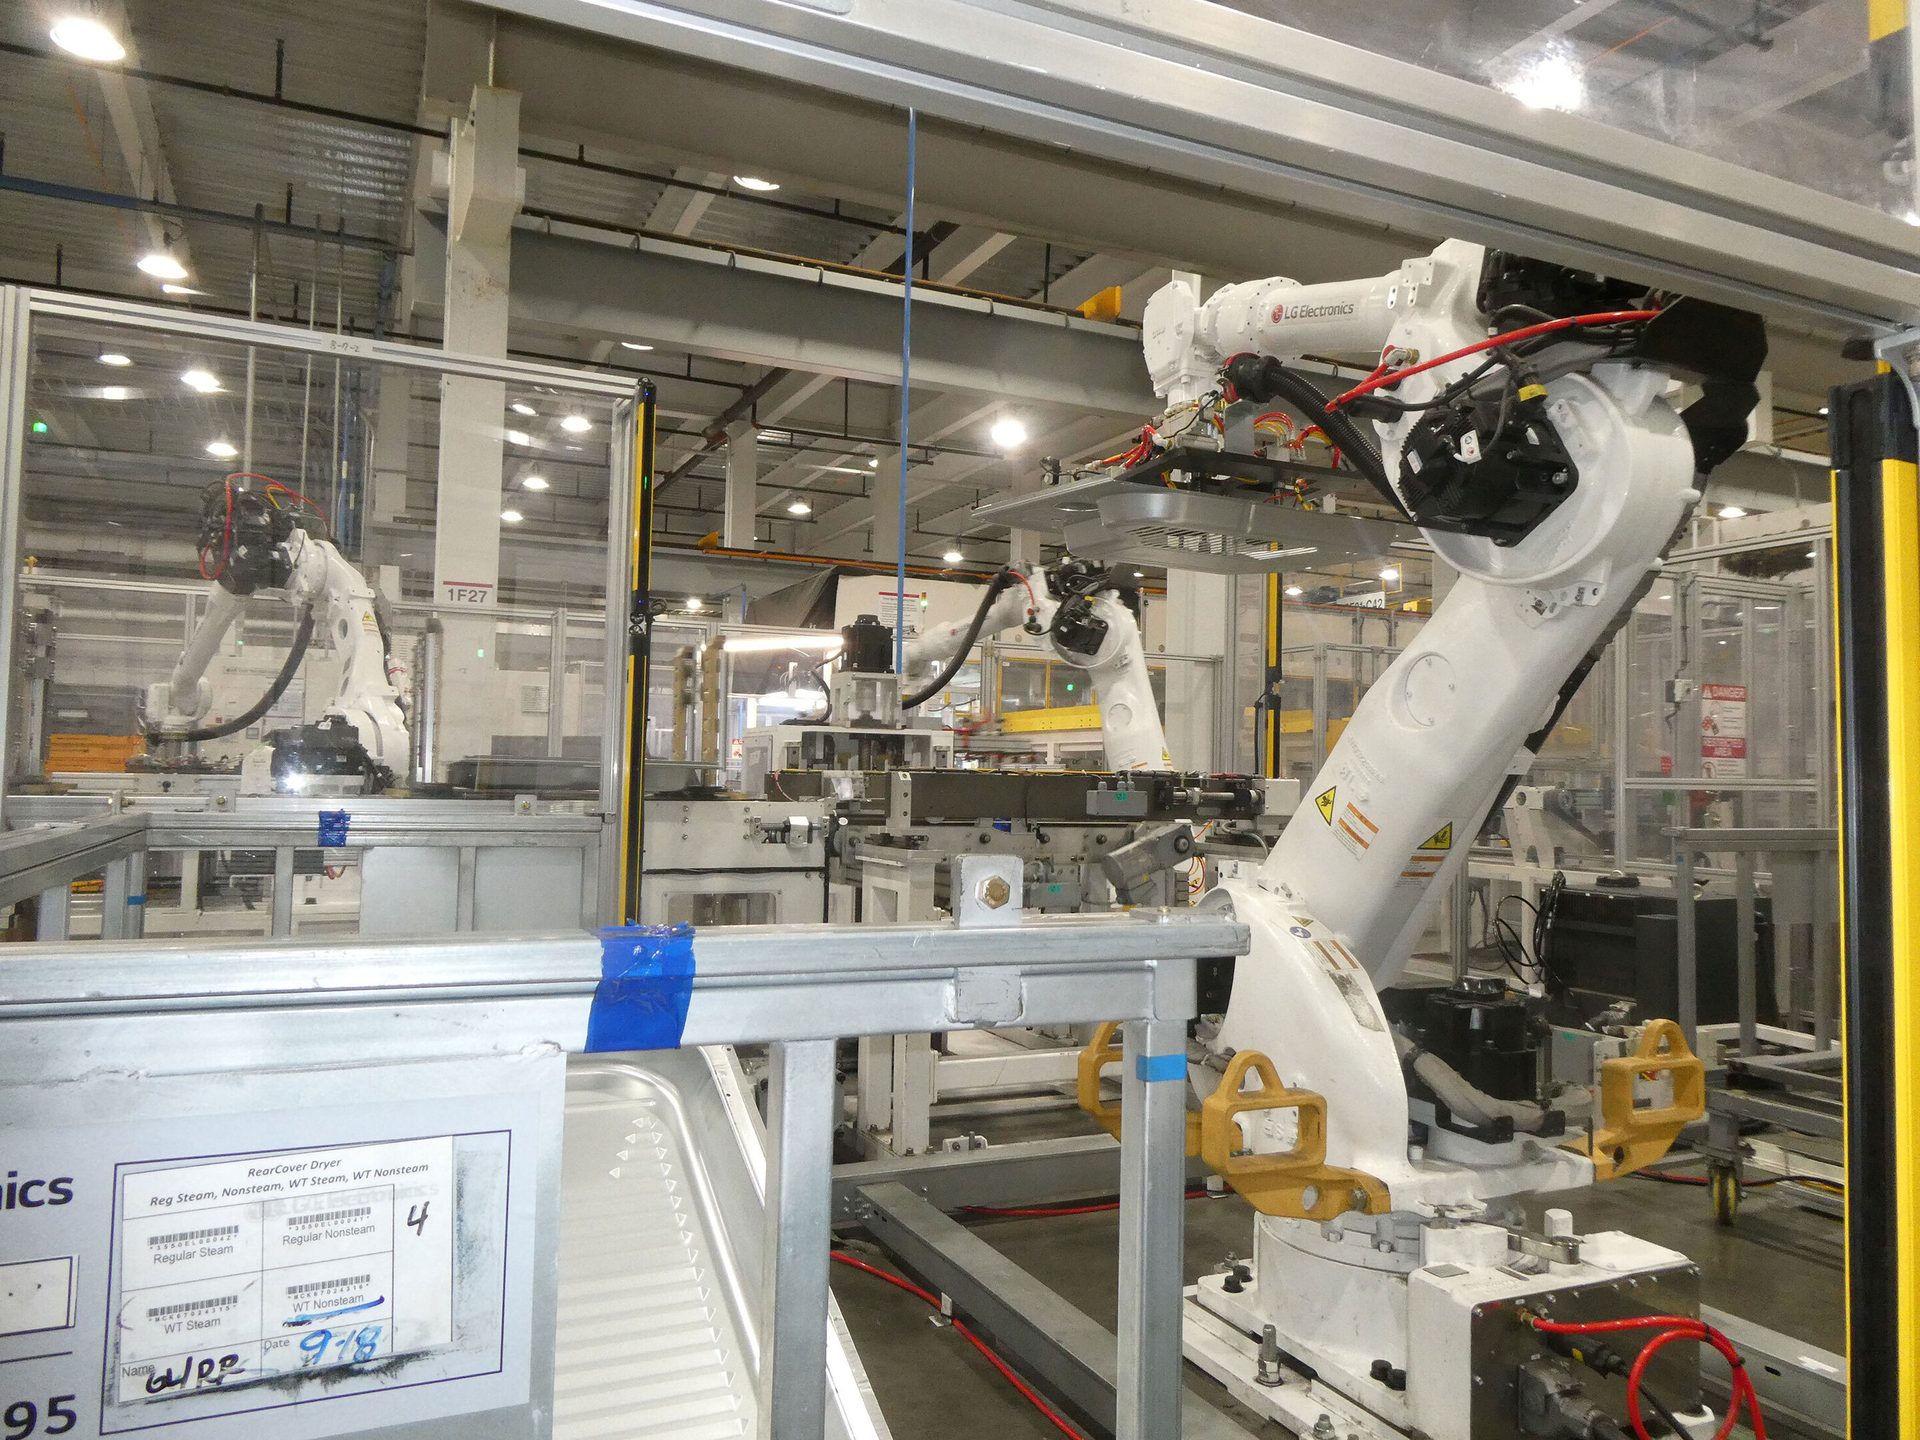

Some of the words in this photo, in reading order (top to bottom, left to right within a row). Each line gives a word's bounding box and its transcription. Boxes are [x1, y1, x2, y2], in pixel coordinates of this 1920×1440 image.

[1284, 305, 1298, 320] LG
[1299, 301, 1354, 318] Electronics
[447, 588, 488, 603] 1F27
[1712, 686, 1746, 698] DANGER
[247, 1162, 307, 1178] RearCover
[310, 1158, 342, 1172] Dryer
[0, 1170, 74, 1209] ics
[150, 1196, 173, 1207] Reg
[176, 1190, 218, 1203] Steam,
[222, 1181, 285, 1197] Nonsteam,
[288, 1177, 309, 1189] WT
[310, 1174, 349, 1186] Steam,
[352, 1169, 372, 1181] WT
[373, 1163, 429, 1178] Nonsteam
[406, 1200, 430, 1237] 4
[282, 1231, 323, 1246] Regular
[325, 1224, 376, 1239] Nonsteam
[153, 1250, 197, 1264] Regular
[199, 1245, 234, 1258] Steam
[292, 1301, 310, 1313] WT
[313, 1294, 364, 1309] Nonsteam
[164, 1321, 183, 1334] WT
[186, 1318, 221, 1331] Steam
[263, 1339, 291, 1351] Date
[299, 1325, 383, 1365] 9-18
[121, 1363, 155, 1378] Name
[4, 1394, 77, 1440] 95
